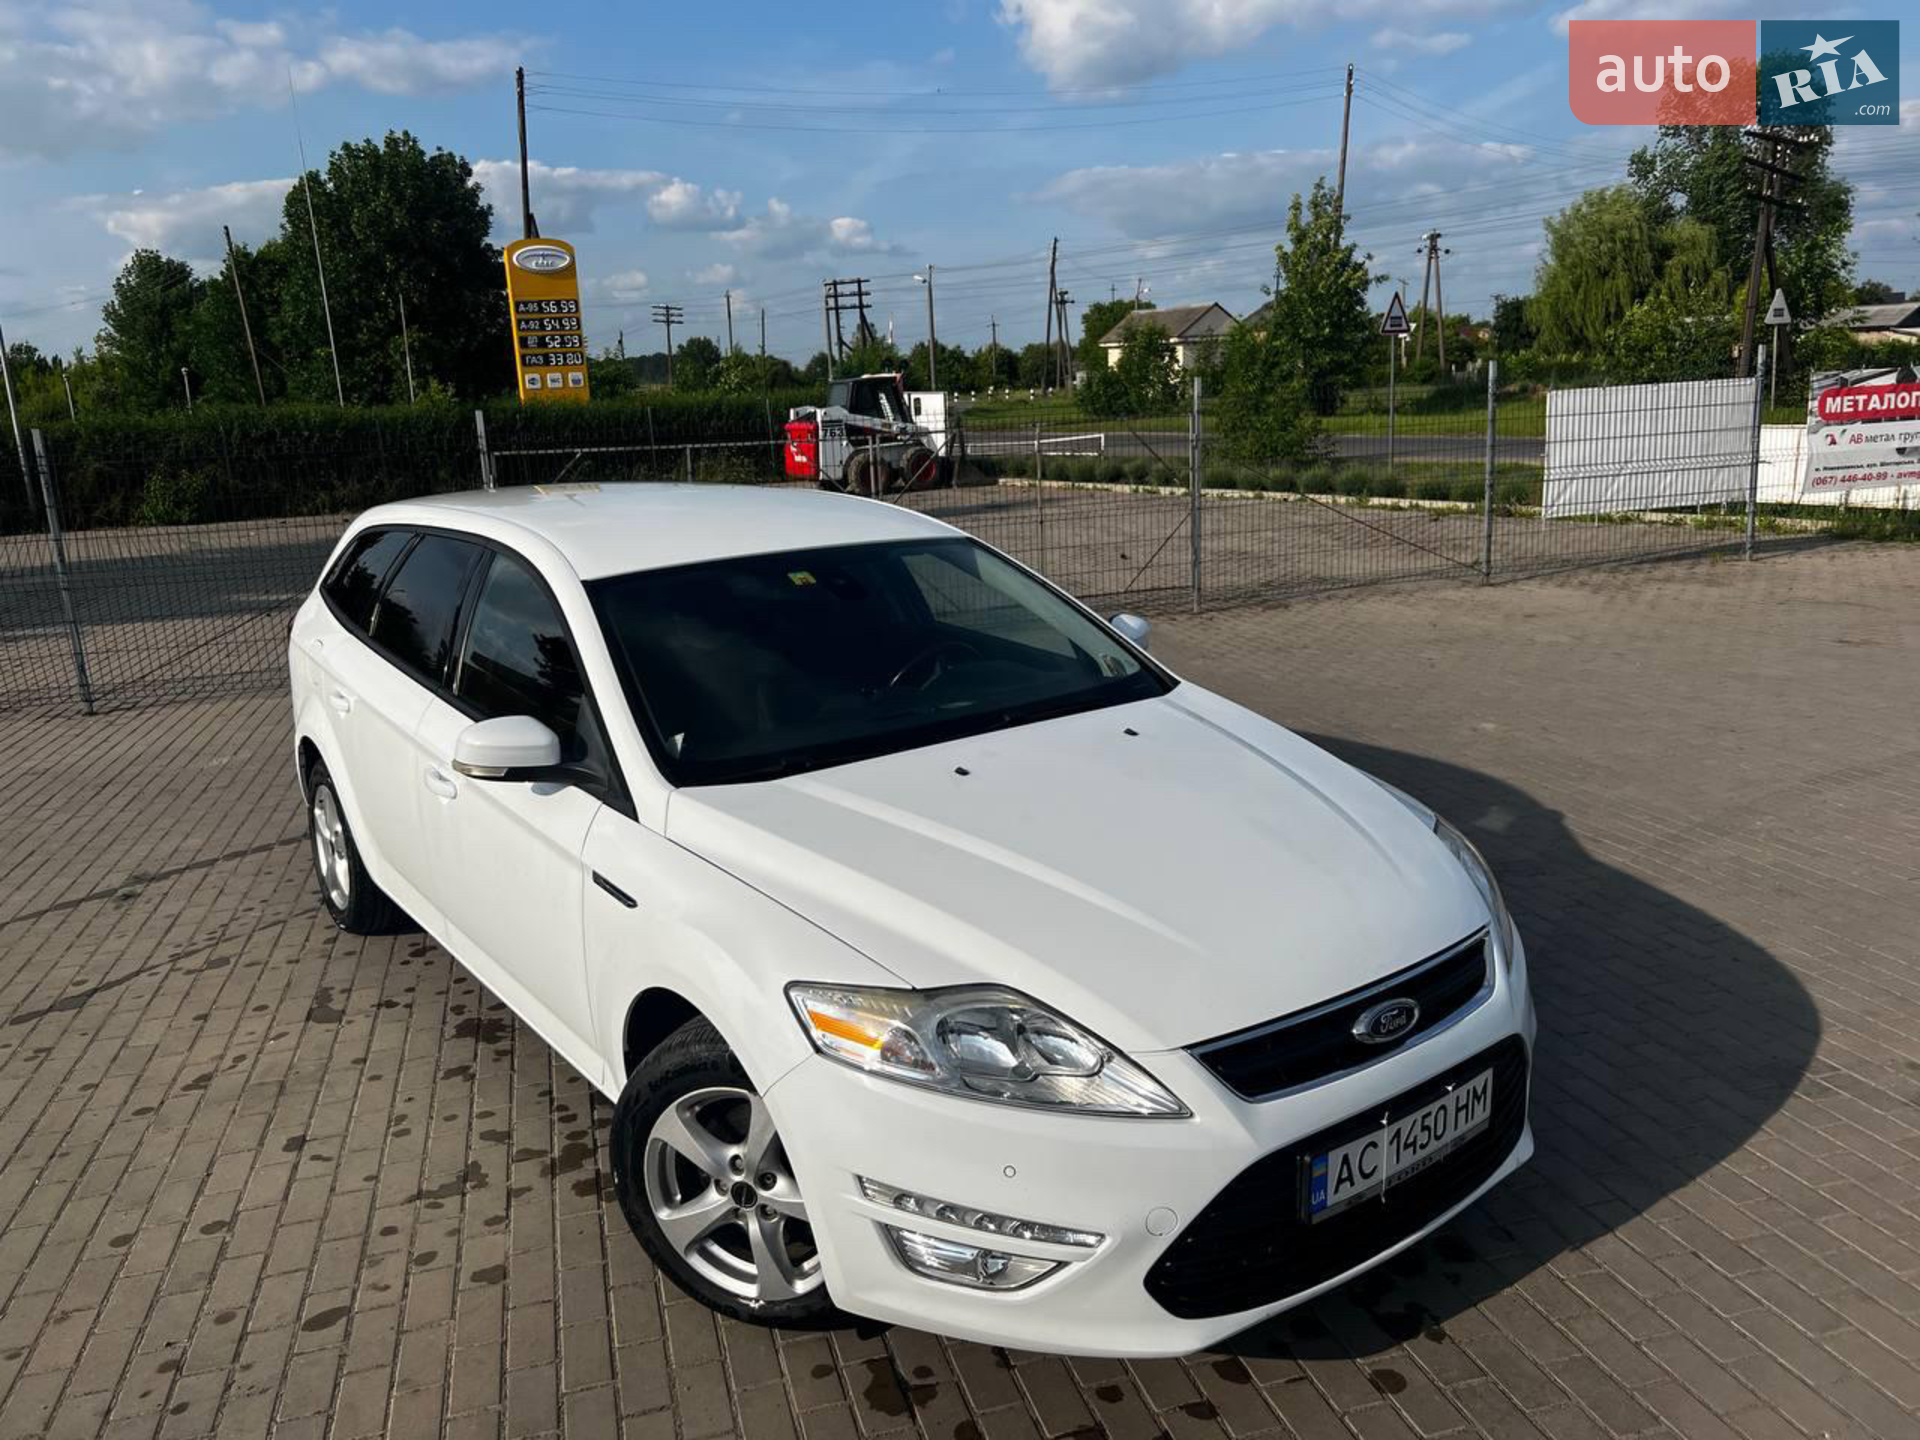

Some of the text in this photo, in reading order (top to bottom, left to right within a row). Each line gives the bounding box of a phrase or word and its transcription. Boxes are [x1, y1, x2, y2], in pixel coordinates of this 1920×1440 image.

[518, 302, 539, 313] А-95
[520, 320, 540, 330] А-92
[525, 355, 544, 365] ГАЗ
[1380, 1008, 1407, 1033] Ford
[1333, 1140, 1379, 1196] AC
[1388, 1103, 1448, 1165] 1450
[1453, 1076, 1489, 1132] HM
[1311, 1189, 1326, 1205] UA
